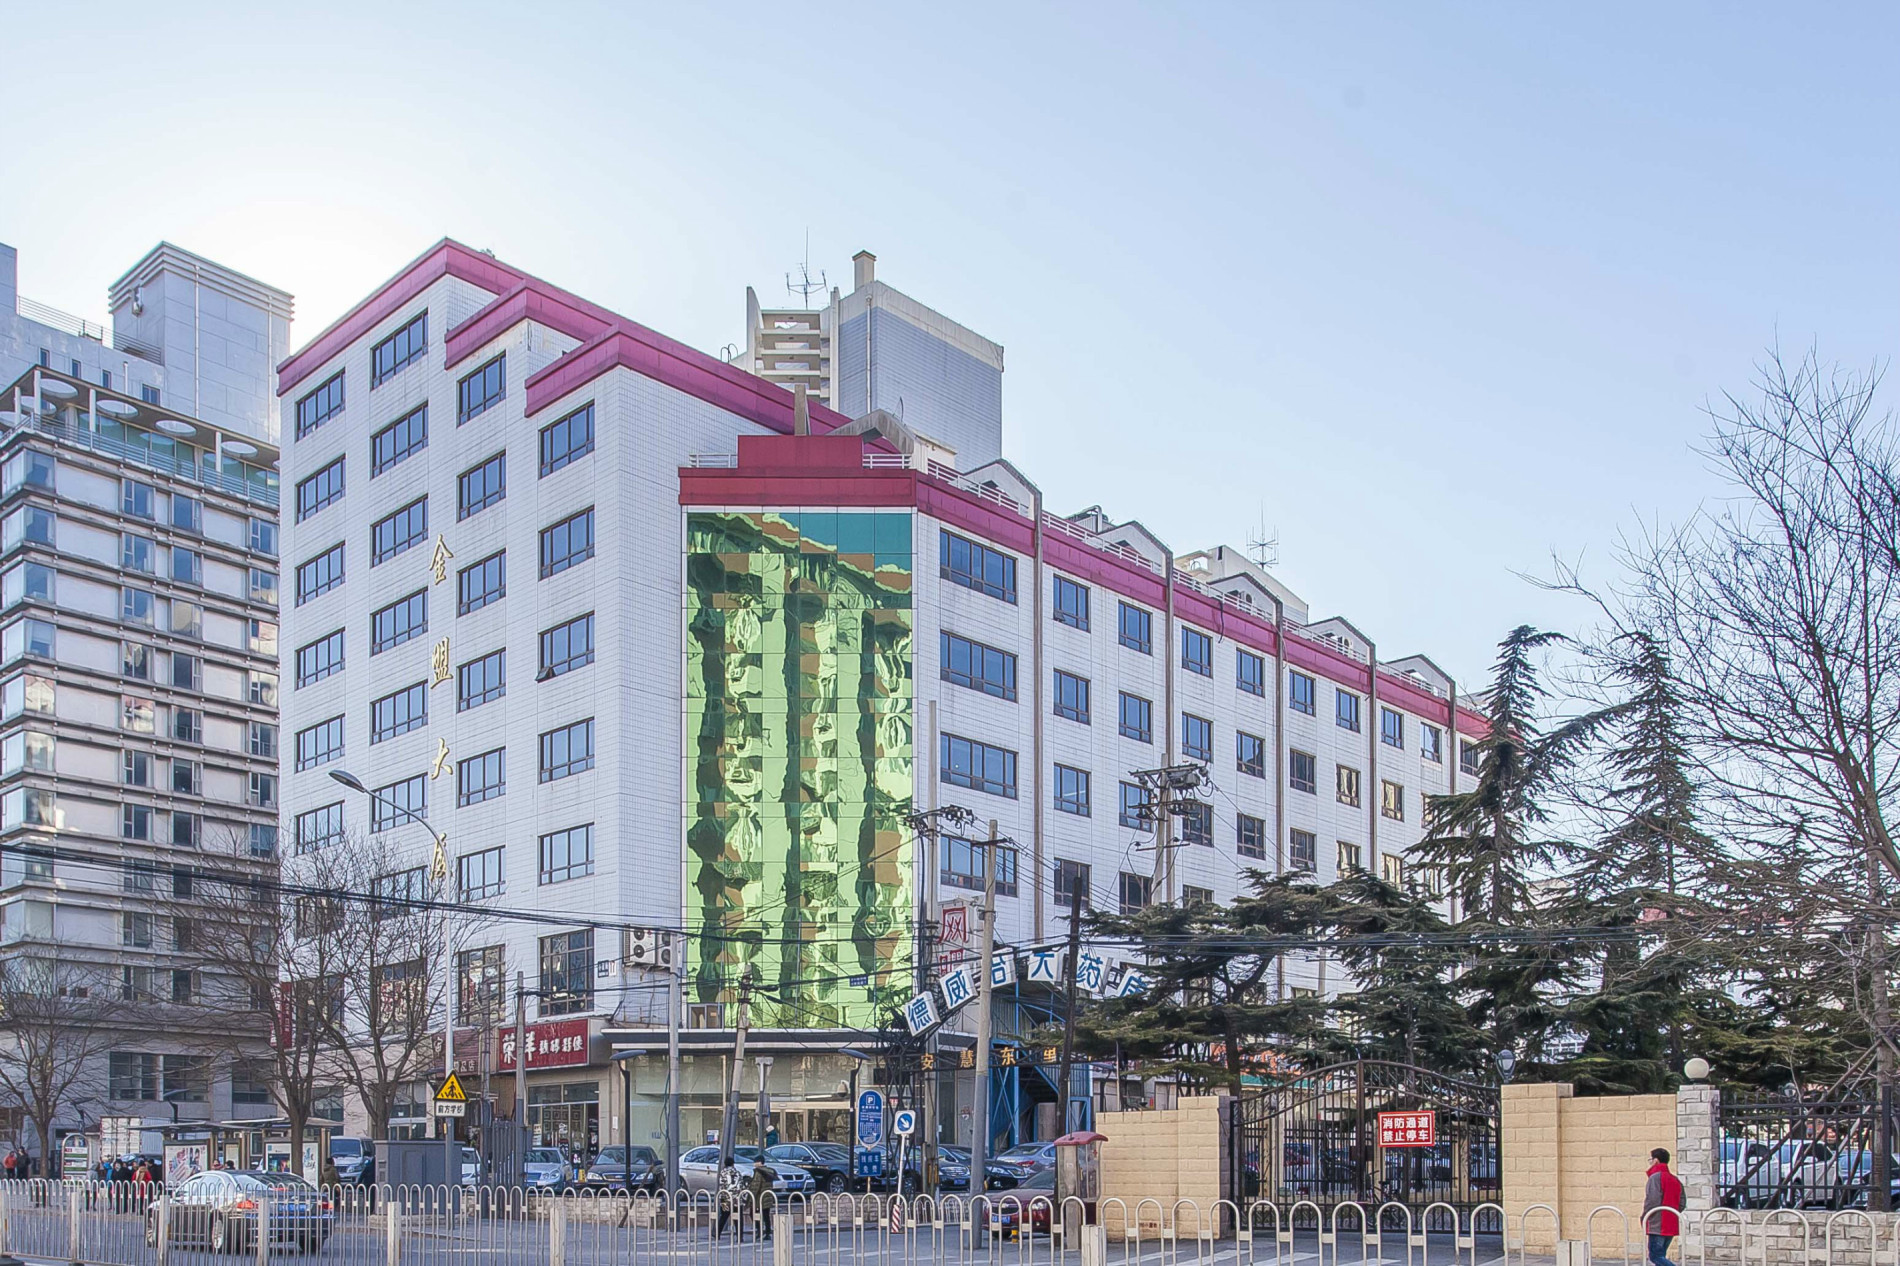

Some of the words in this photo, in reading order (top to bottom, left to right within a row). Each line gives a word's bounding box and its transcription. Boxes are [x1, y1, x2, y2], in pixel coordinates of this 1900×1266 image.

[1383, 1117, 1429, 1129] 消防通道
[1383, 1130, 1429, 1142] 禁止停车
